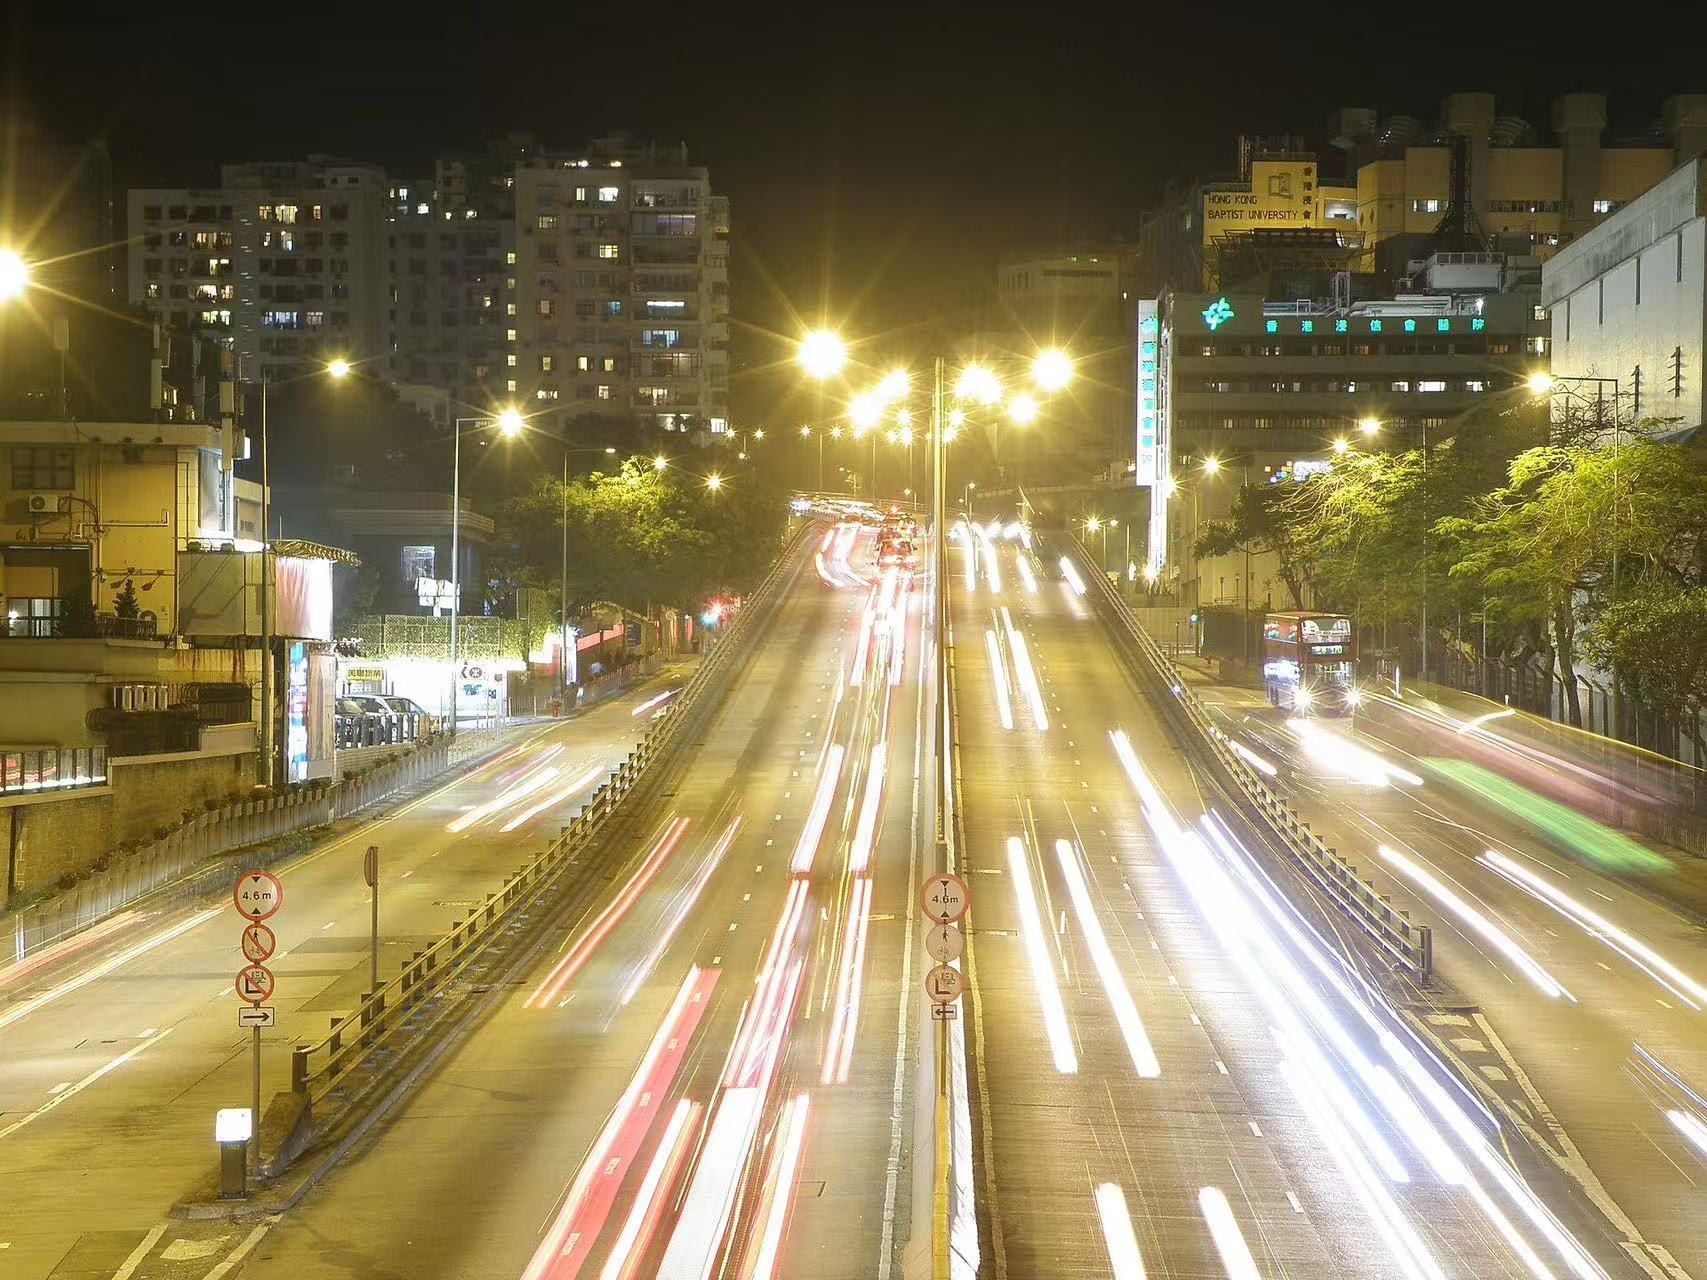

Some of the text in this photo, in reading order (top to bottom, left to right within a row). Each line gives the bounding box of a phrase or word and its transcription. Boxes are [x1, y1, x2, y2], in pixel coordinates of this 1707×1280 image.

[1208, 195, 1258, 205] HONG KONG
[1208, 210, 1298, 220] BAPTIST UNIVERSITY
[1266, 318, 1487, 334] 香港浸信會醫院
